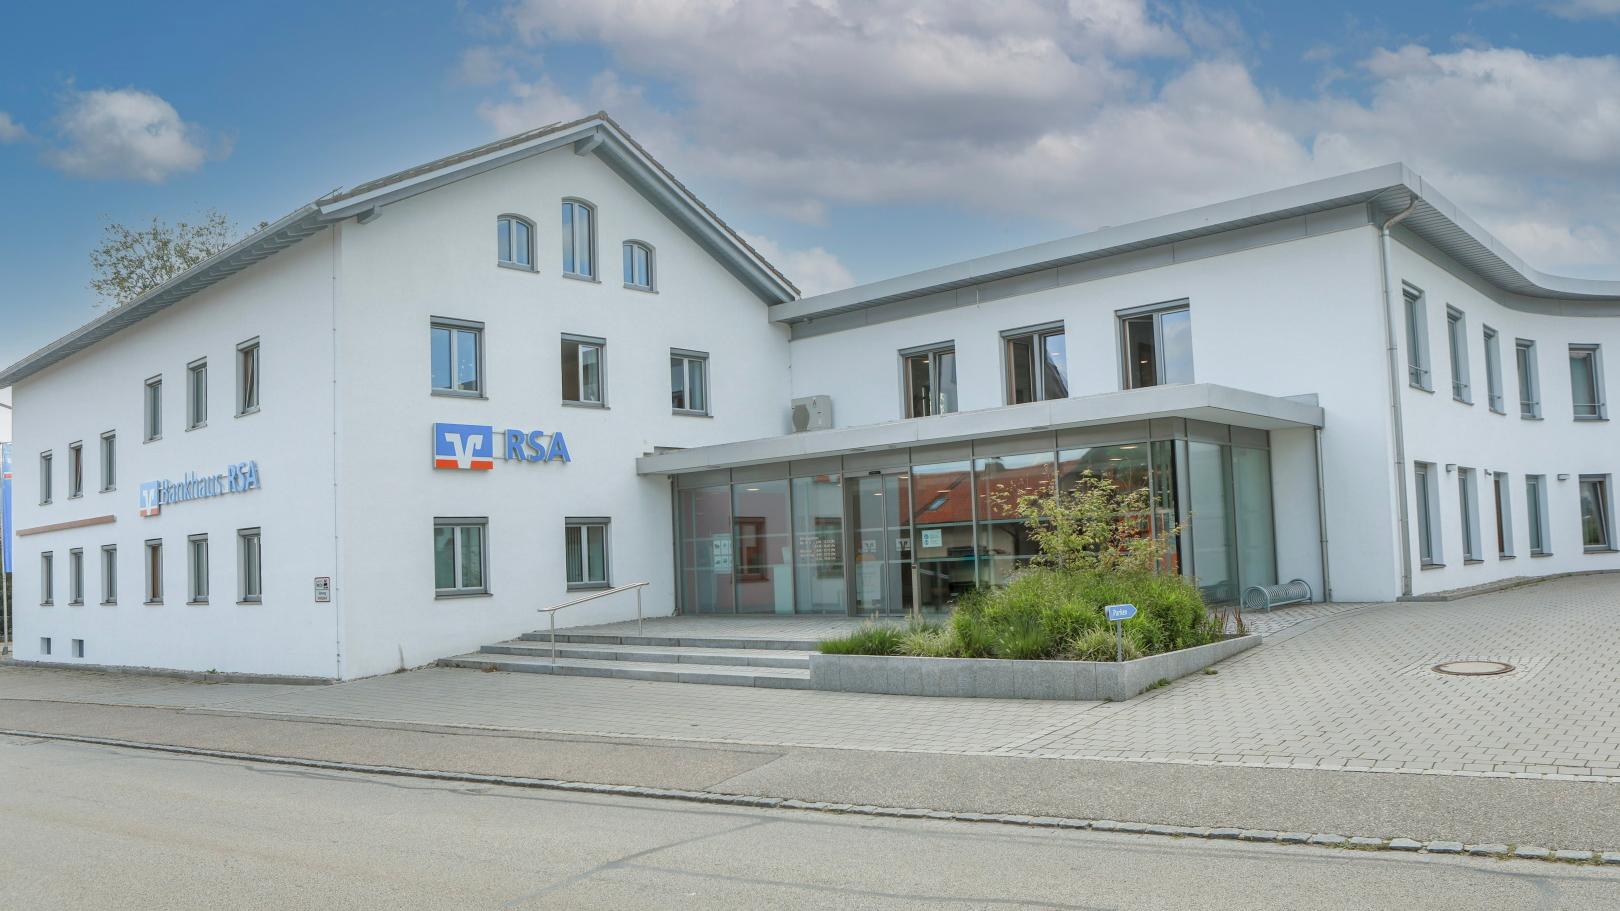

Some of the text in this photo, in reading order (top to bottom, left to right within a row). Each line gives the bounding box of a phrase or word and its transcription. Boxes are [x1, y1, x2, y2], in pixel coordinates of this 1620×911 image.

[505, 429, 571, 463] RSA
[161, 460, 260, 505] Bankhaus RSA
